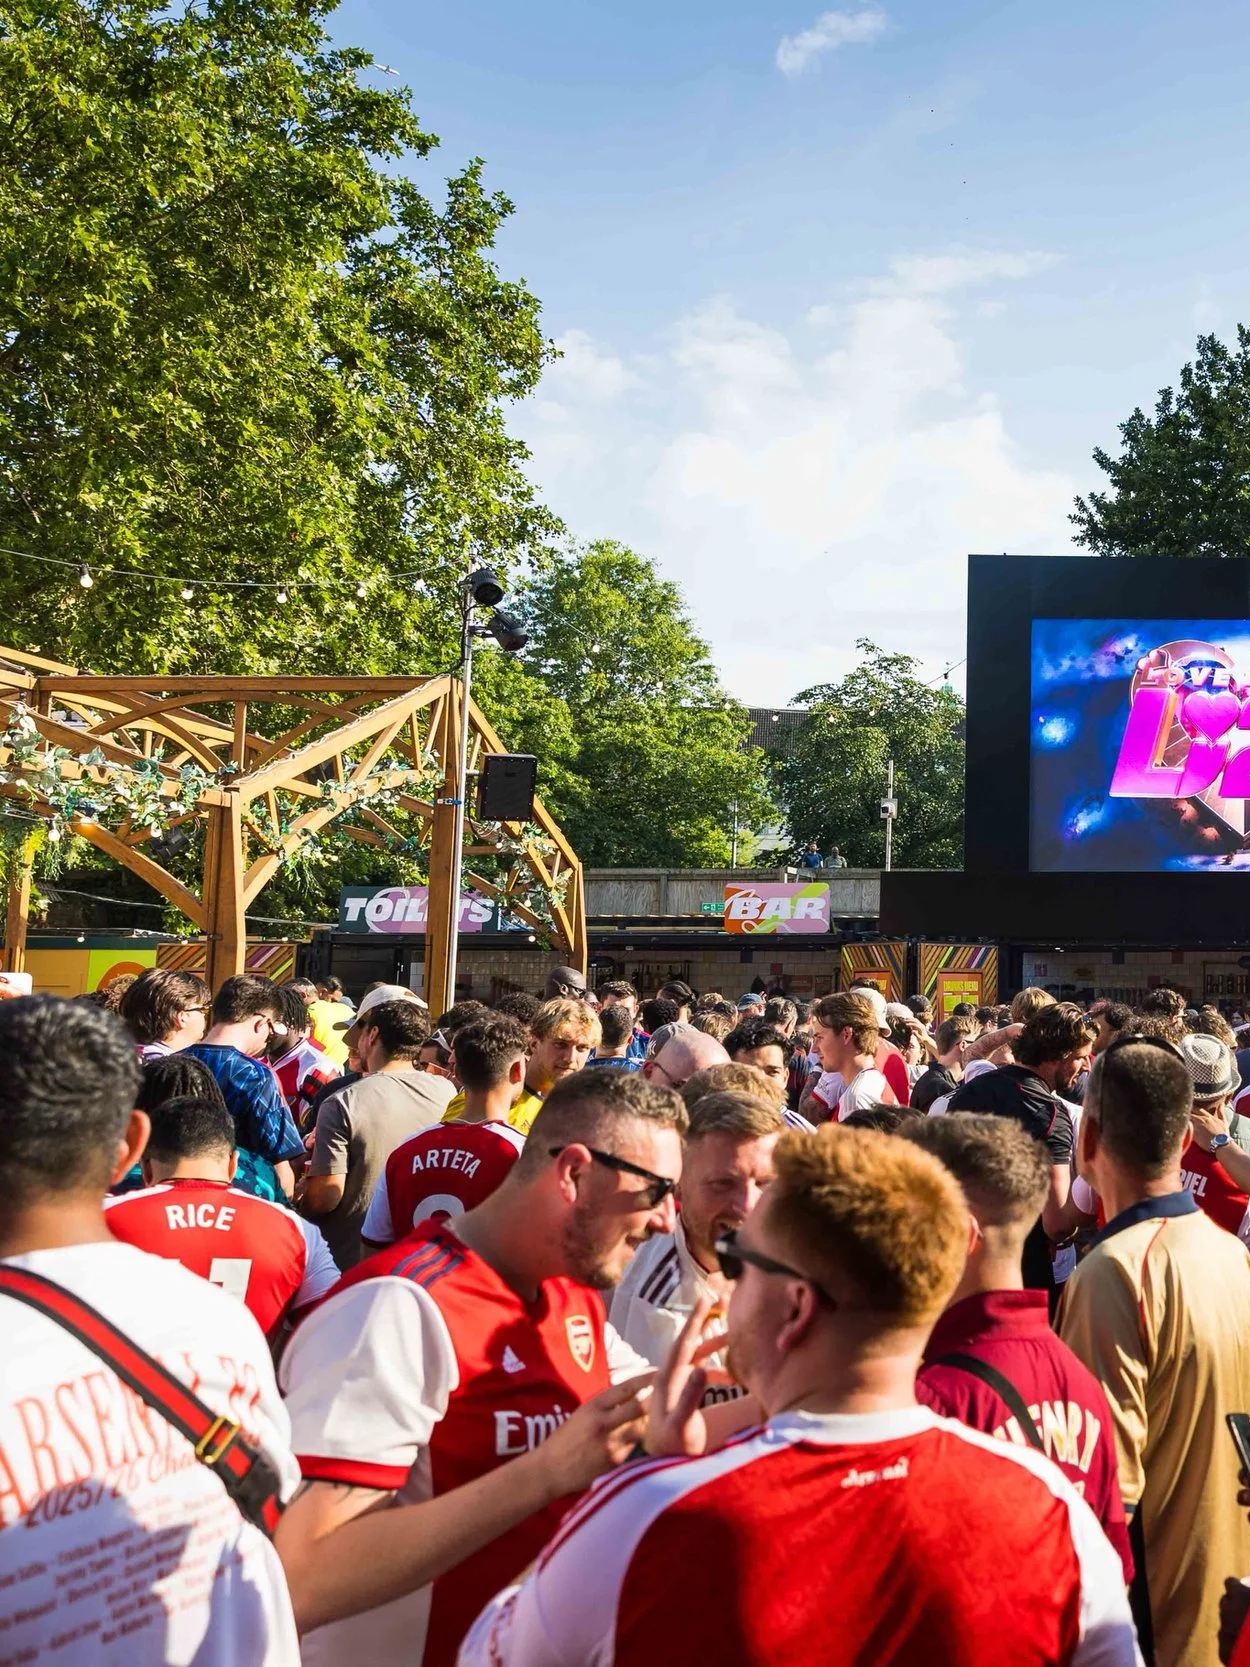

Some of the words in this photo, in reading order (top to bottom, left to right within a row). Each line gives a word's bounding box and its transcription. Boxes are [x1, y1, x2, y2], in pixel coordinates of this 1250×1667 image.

[1139, 664, 1232, 688] LOVE
[344, 897, 494, 923] TOILTS
[728, 897, 827, 920] BAR
[411, 1148, 482, 1179] ARTETA
[165, 1203, 237, 1232] RICE
